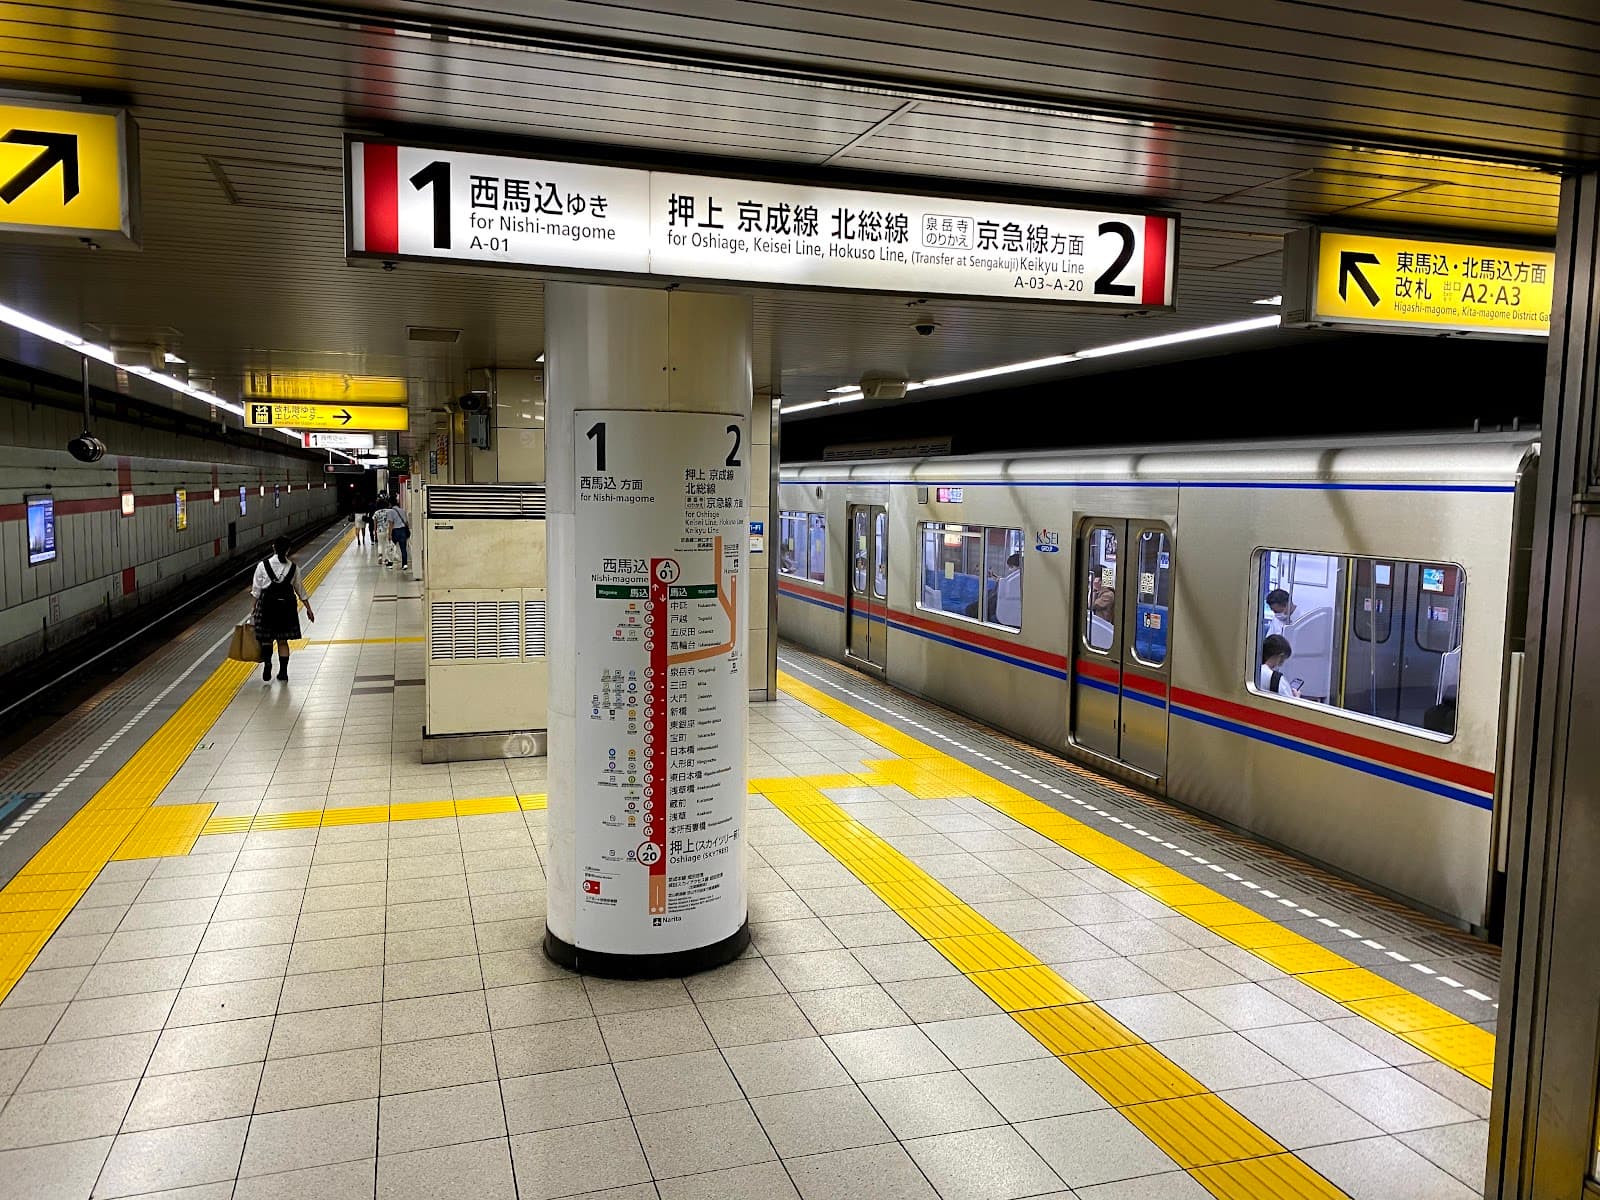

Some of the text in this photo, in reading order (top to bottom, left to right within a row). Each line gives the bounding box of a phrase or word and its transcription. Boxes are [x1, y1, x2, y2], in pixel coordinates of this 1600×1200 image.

[470, 174, 609, 219] 西馬込ゆき
[409, 160, 452, 250] 1
[668, 193, 910, 245] 押上 京成線 北総線
[926, 217, 970, 233] 泉岳寺
[470, 213, 616, 242] for Nishi-magome
[470, 236, 510, 253] A-01
[926, 232, 968, 248] のりかえ
[976, 220, 1085, 257] 京急線方面
[668, 230, 687, 246] for
[691, 231, 749, 253] Oshiage,
[753, 237, 791, 256] Keisei
[795, 240, 825, 259] Line,
[828, 244, 876, 261] Hokuso
[879, 247, 908, 265] Line,
[911, 250, 955, 267] (Transfer
[956, 256, 966, 267] at
[1062, 259, 1085, 275] Line
[1093, 220, 1137, 297] 2
[1395, 277, 1433, 301] 改札
[1443, 281, 1462, 292] 出口
[1394, 301, 1550, 322] Higashi-magome, Kita-magome District Ga
[275, 412, 325, 421] エレベーター
[312, 434, 318, 446] 1
[586, 422, 607, 472] 1
[725, 424, 742, 467] 2
[685, 468, 734, 481] 押上 京成線
[580, 476, 643, 491] 西馬込 方面
[685, 482, 716, 495] 北総線
[580, 493, 655, 504] for Nishi-magome
[602, 558, 649, 574] 西馬込
[591, 574, 649, 585] Nishi-magome
[659, 570, 674, 580] 01
[669, 587, 688, 597] 馬込
[642, 852, 657, 862] 20
[669, 854, 701, 864] Oshiage
